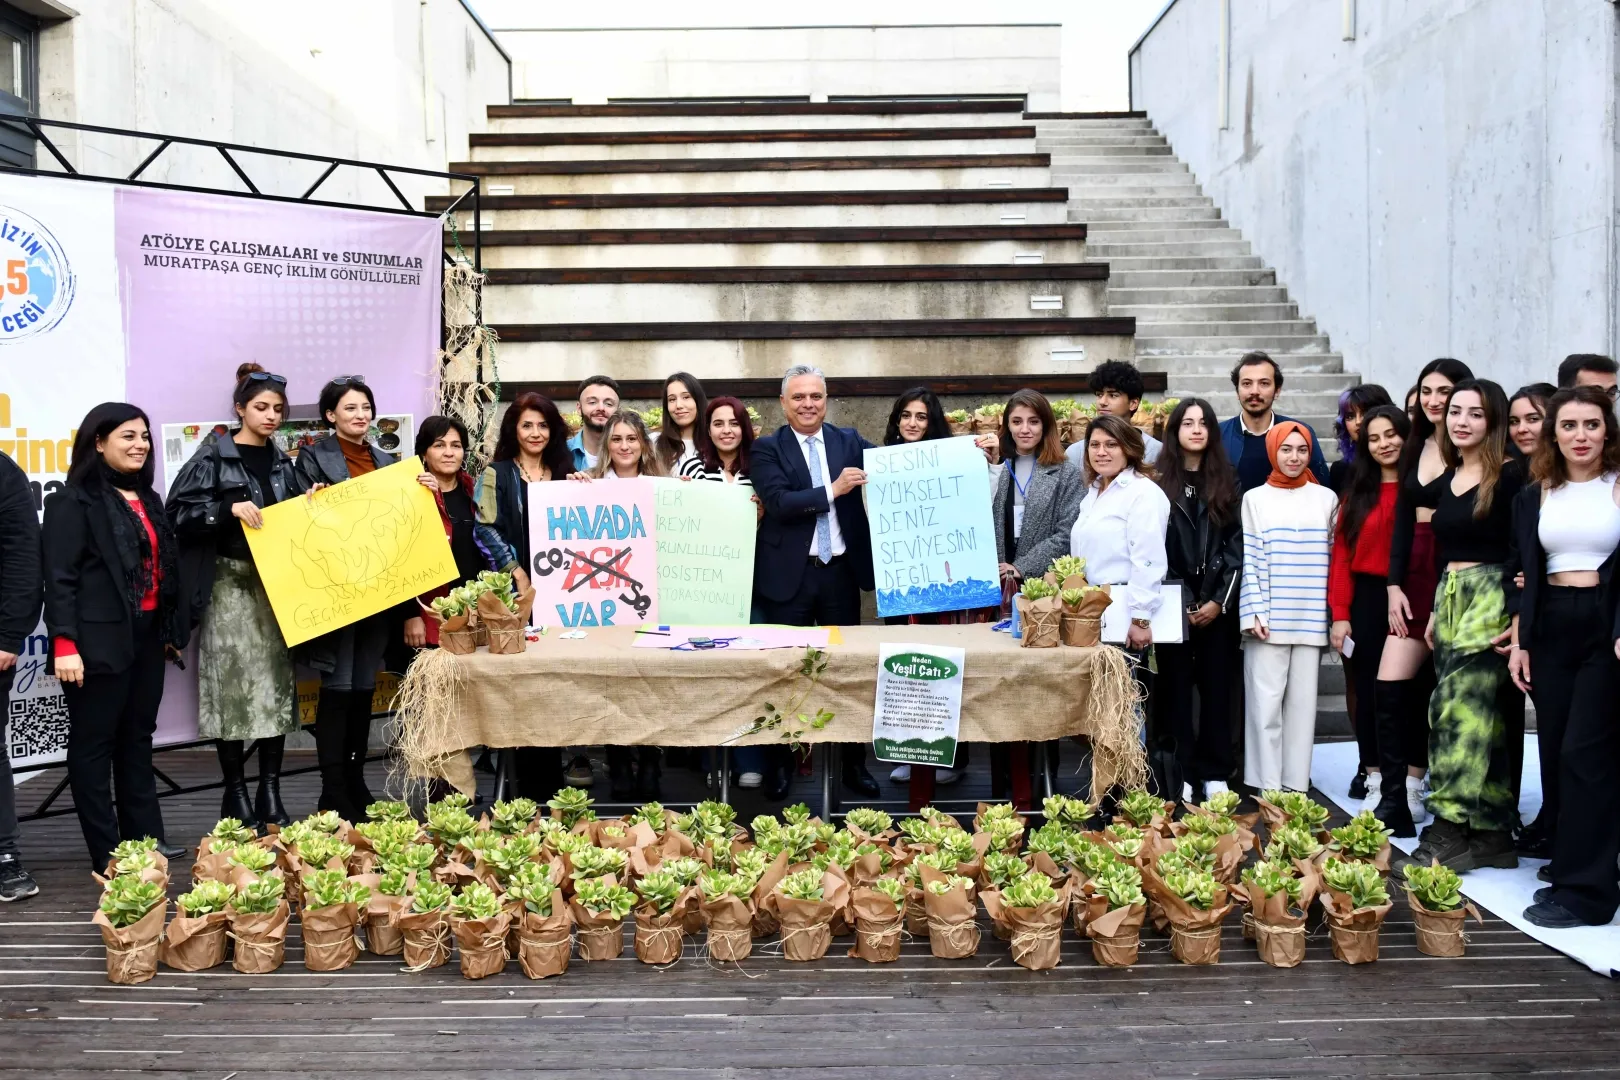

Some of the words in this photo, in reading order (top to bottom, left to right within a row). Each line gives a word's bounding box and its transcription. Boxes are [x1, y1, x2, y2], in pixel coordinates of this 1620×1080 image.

[140, 233, 205, 251] ATÖLYE
[209, 239, 318, 261] ÇALIŞMALARI
[322, 252, 338, 262] ve
[342, 251, 423, 269] SUNUMLAR
[143, 254, 240, 274] MURATPAŞA
[243, 262, 283, 278] GENÇ
[286, 262, 327, 279] İKLİM
[330, 267, 420, 285] GÖNÜLLÜLERİ
[875, 444, 939, 474] SESİNİ
[875, 475, 964, 505] YÜKSELT
[546, 503, 647, 541] HAVADA
[877, 505, 939, 535] DENİZ
[880, 526, 977, 564] SEVİYESİNİ
[881, 563, 939, 591] DEĞİL
[555, 599, 617, 627] VAR
[891, 662, 916, 677] Yeşil
[918, 664, 941, 678] Çatı
[911, 655, 932, 664] Neden
